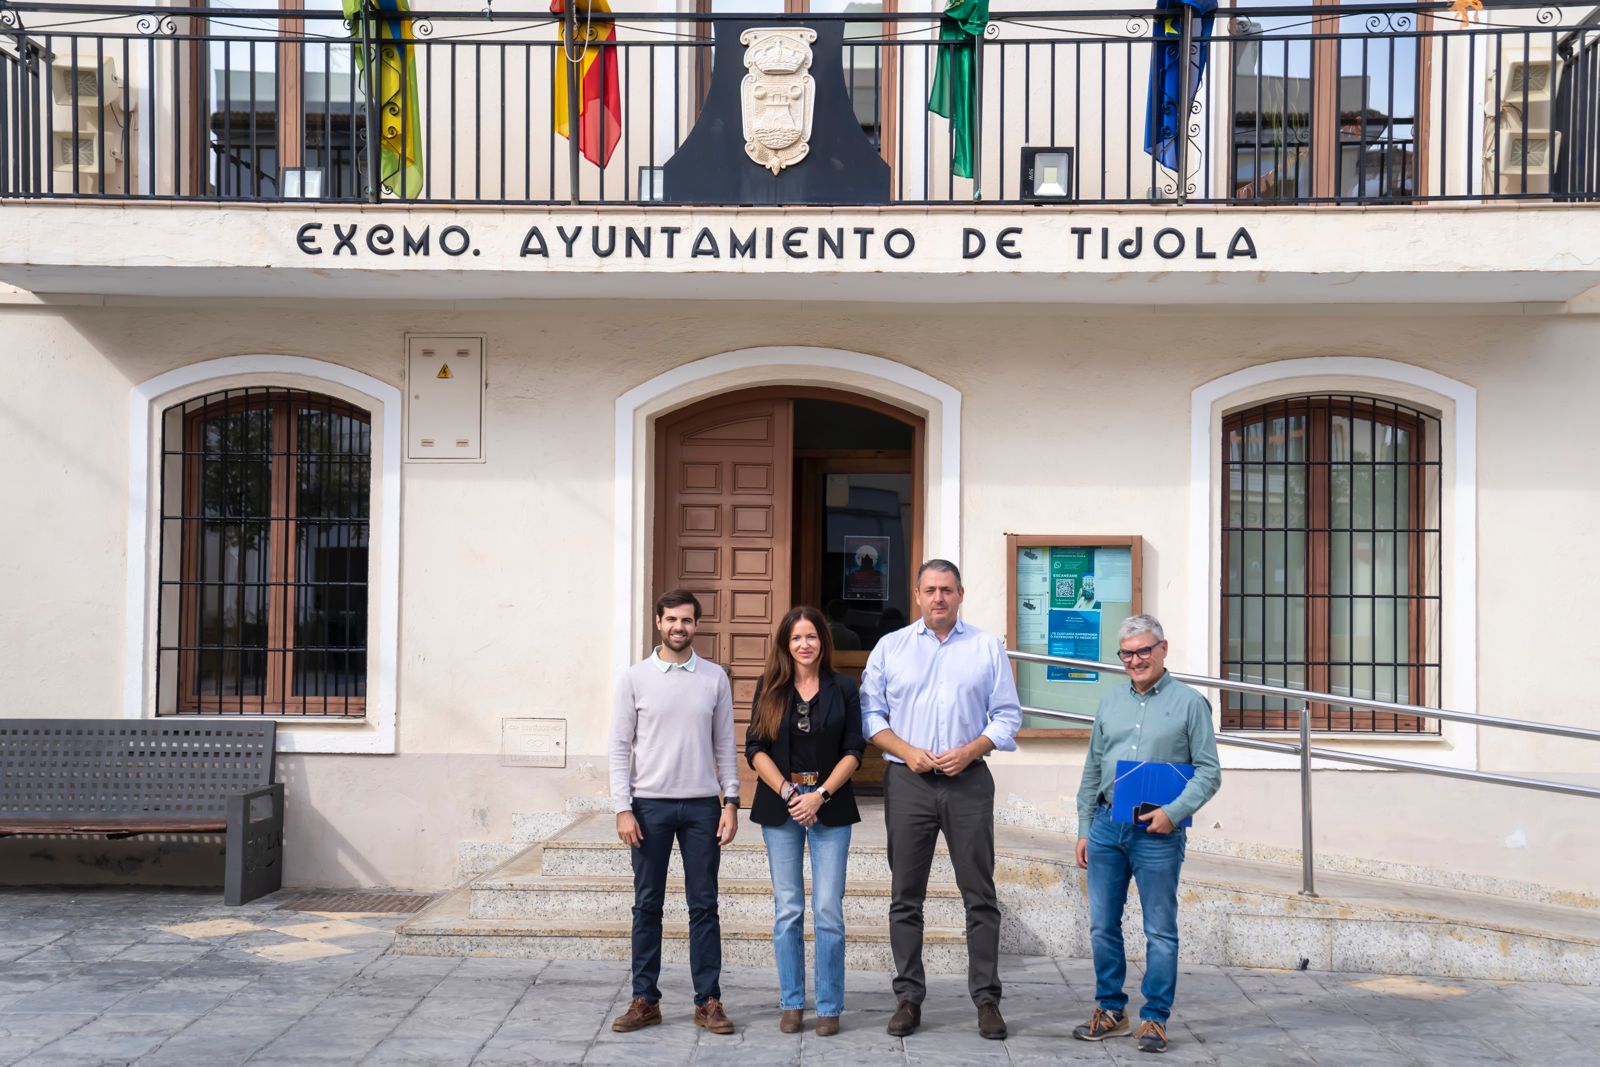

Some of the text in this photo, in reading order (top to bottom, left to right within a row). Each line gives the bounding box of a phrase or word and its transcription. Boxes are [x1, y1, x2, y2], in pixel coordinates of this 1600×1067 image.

[296, 222, 1258, 260] EXCMO. AYUNTAMIENTO DE TIJOLA
